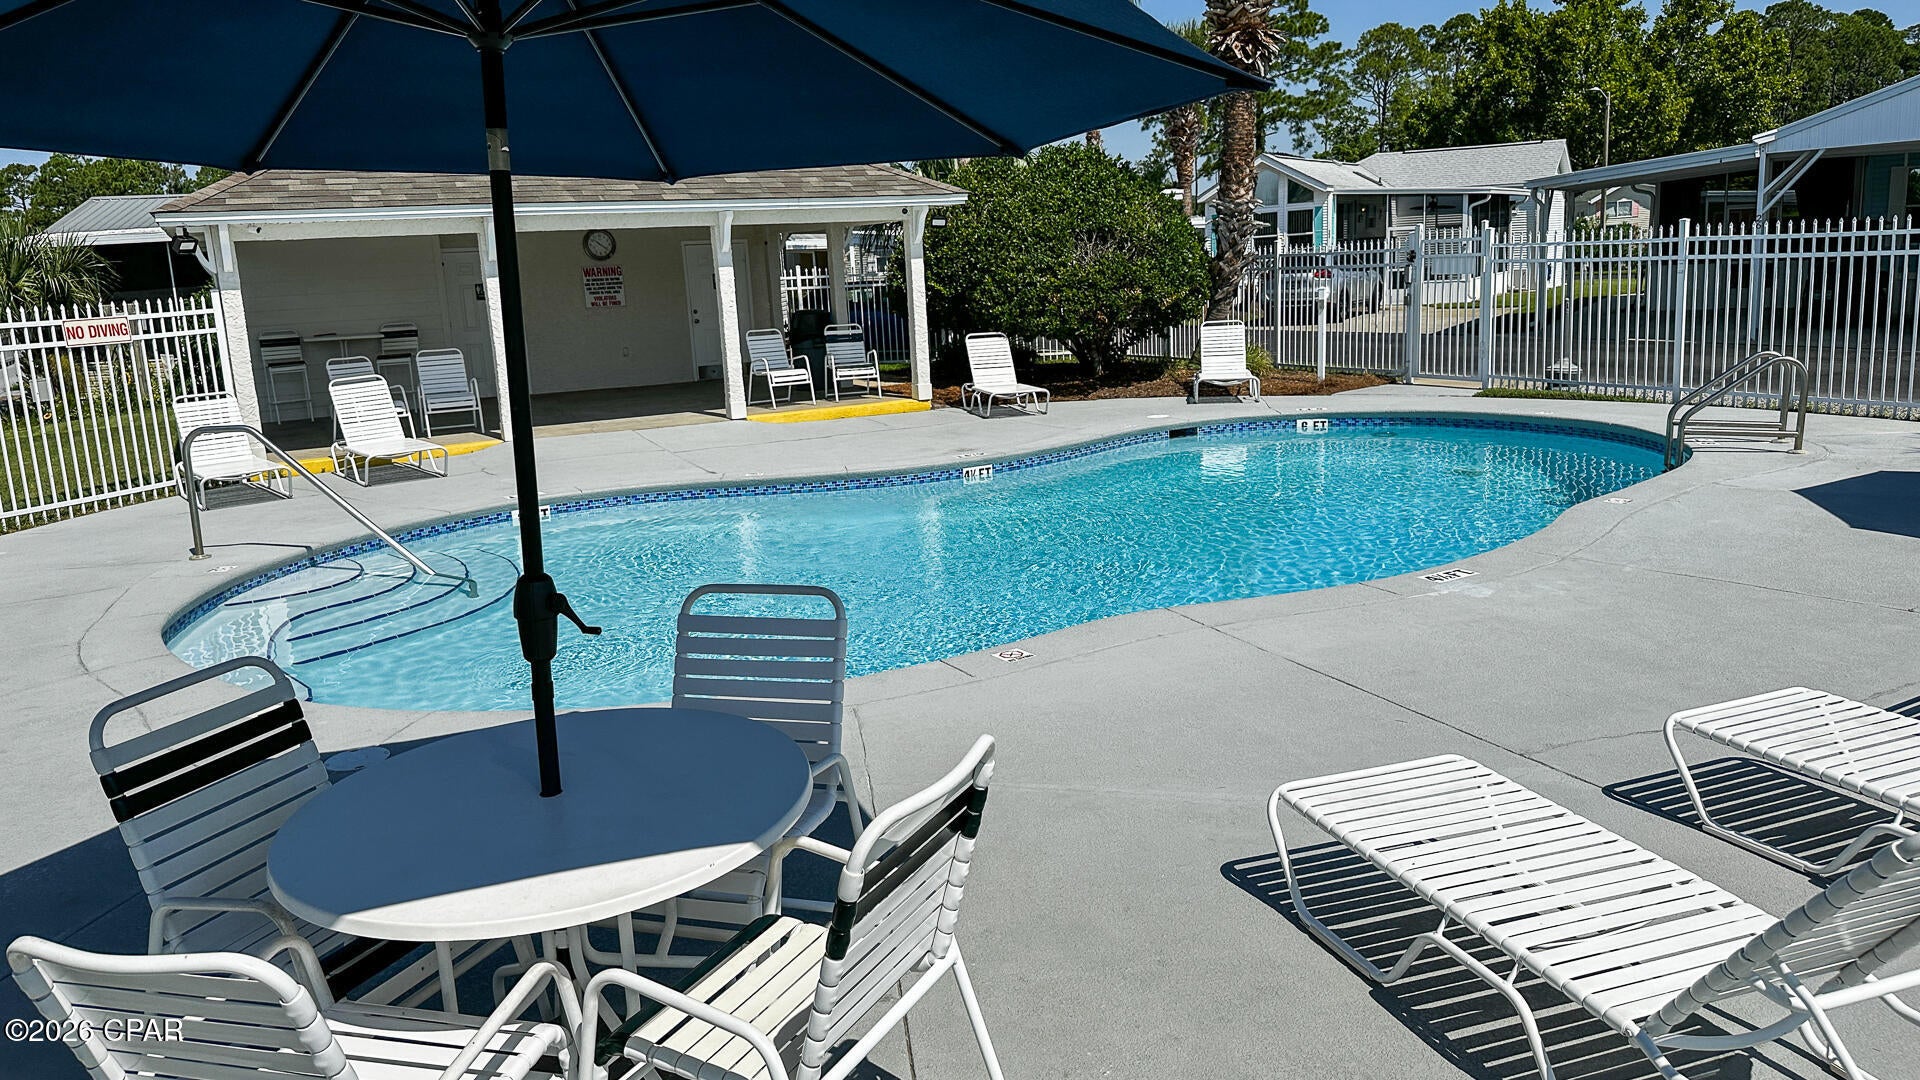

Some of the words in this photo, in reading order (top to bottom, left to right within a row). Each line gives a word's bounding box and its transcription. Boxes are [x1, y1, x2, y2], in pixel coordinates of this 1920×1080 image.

[583, 265, 622, 277] WARNING
[66, 326, 84, 340] NO
[88, 323, 129, 338] DIVING
